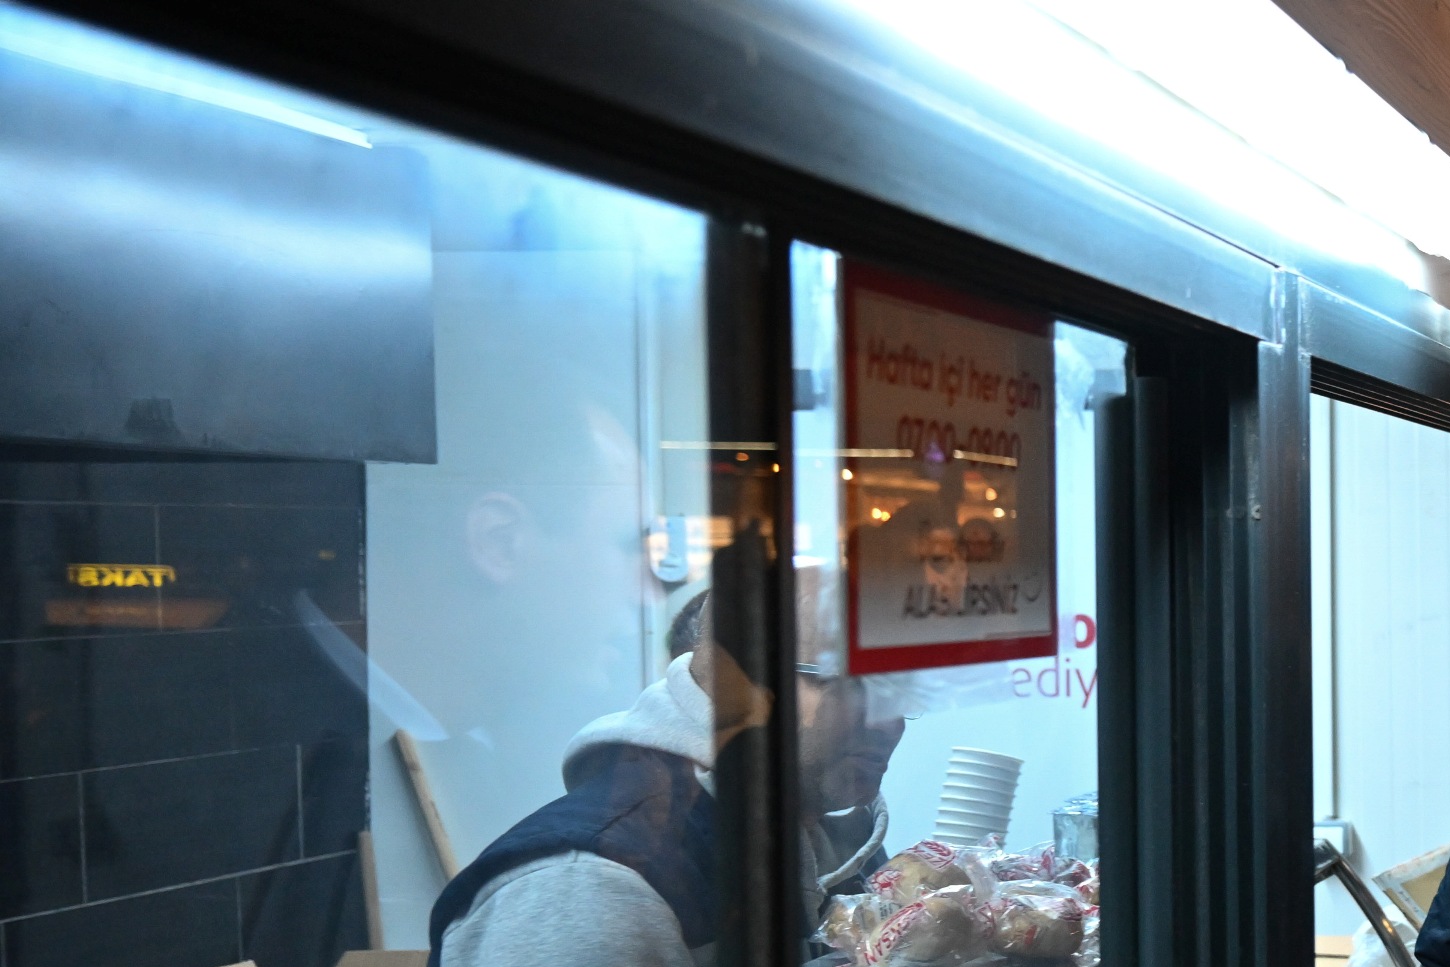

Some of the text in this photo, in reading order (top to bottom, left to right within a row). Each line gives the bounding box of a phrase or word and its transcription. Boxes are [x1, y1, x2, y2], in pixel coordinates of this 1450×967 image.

[866, 336, 933, 391] Hafta
[967, 355, 1002, 403] her
[1006, 370, 1042, 418] gün
